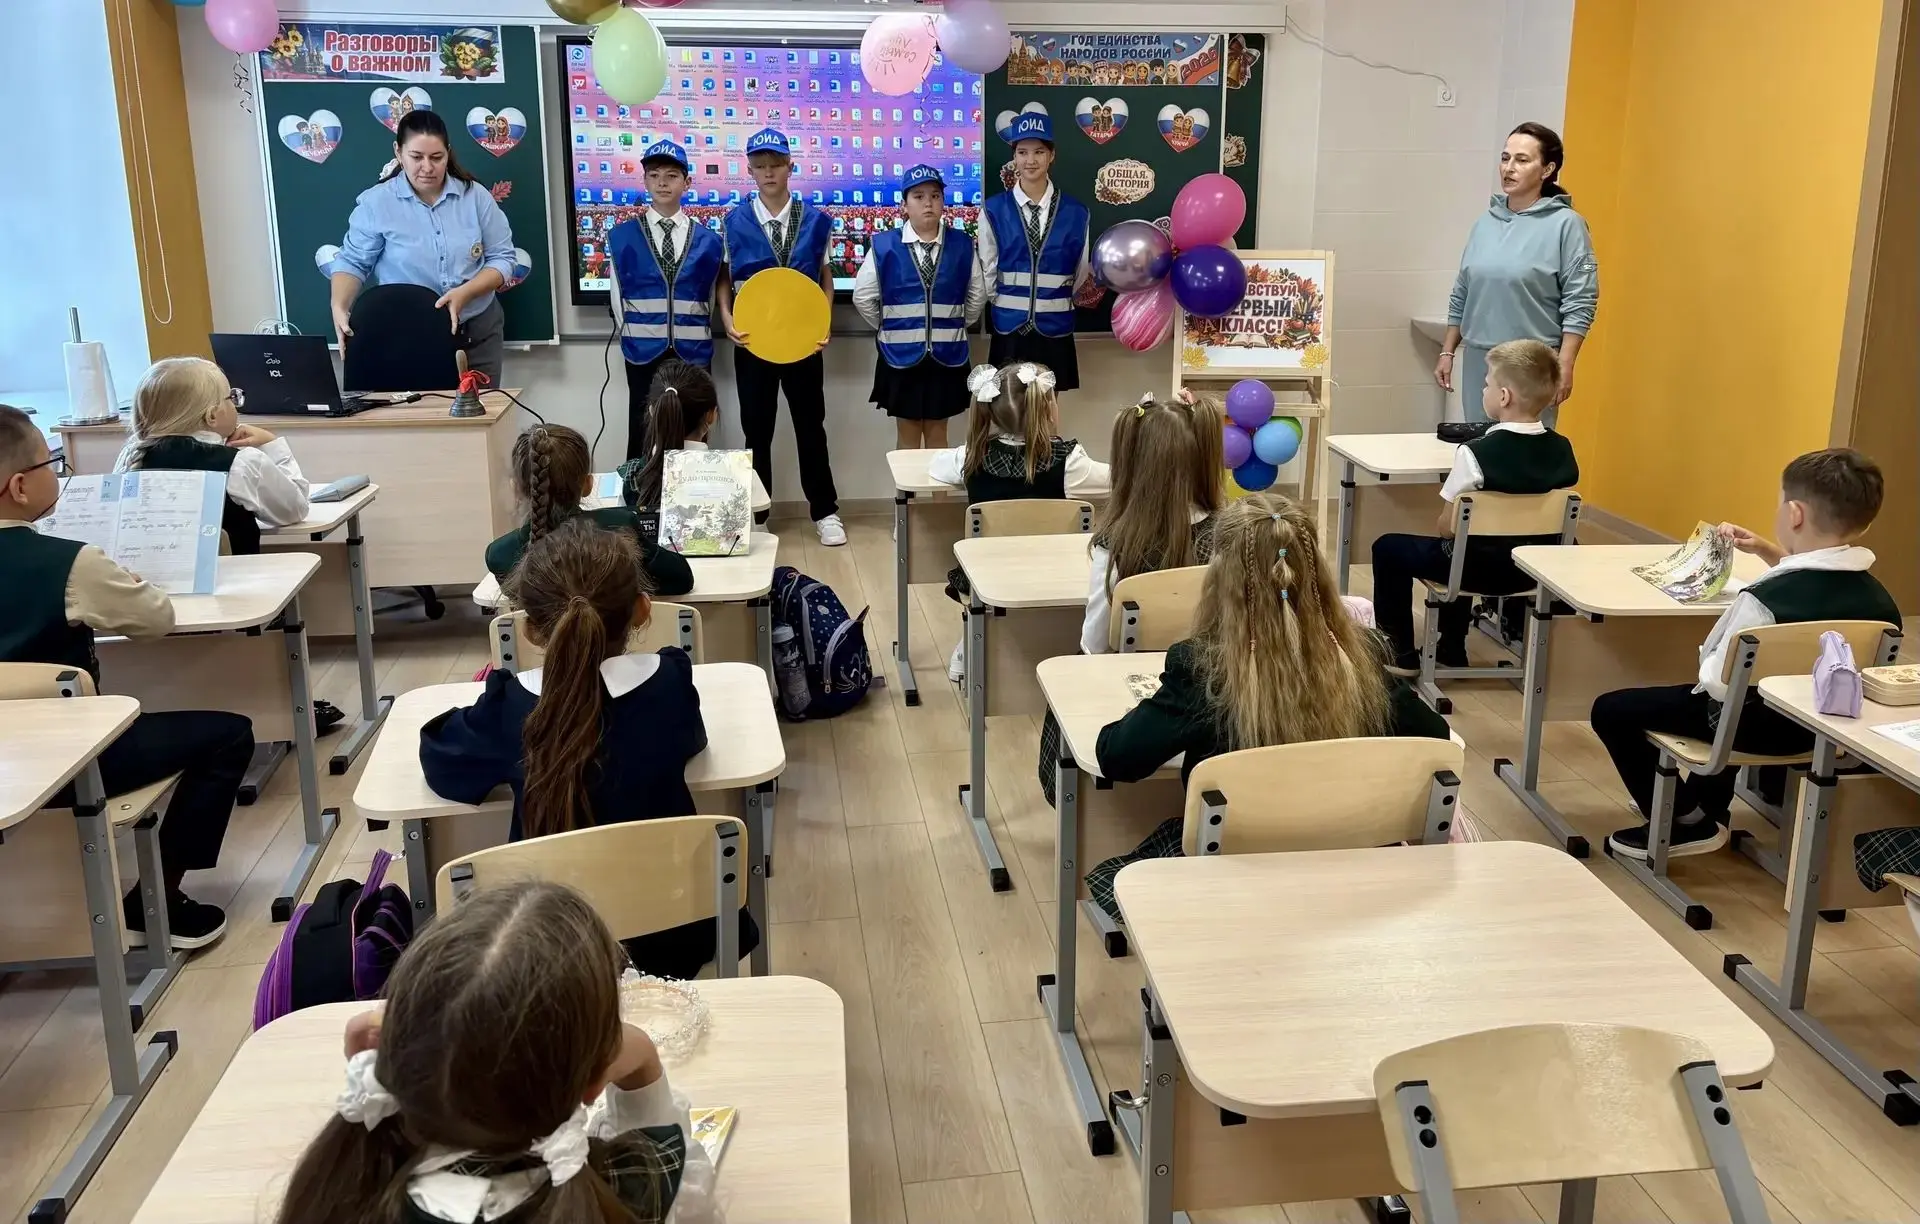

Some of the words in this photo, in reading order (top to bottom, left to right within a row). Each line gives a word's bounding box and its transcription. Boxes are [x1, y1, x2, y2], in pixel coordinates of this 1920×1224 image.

[325, 31, 438, 55] Разговоры
[1070, 35, 1094, 46] ГОД
[1097, 35, 1161, 46] ЕДИНСТВА
[1061, 48, 1118, 60] НАРОДОВ
[1121, 48, 1171, 59] РОССИИ
[331, 55, 343, 71] о
[350, 54, 431, 72] важном
[1180, 46, 1218, 81] 2026
[1018, 118, 1045, 135] ЮИД
[754, 133, 781, 146] ЮИД
[1089, 130, 1114, 139] ТАТАРЫ
[480, 140, 516, 151] БАШКИРЫ
[650, 144, 677, 158] ЮИД
[911, 165, 938, 180] ЮИД
[1106, 178, 1150, 190] ИСТОРИЯ
[1245, 283, 1300, 299] ВСТВУЙ,
[1230, 298, 1291, 317] РВЫЙ
[1220, 317, 1283, 333] КЛАСС!
